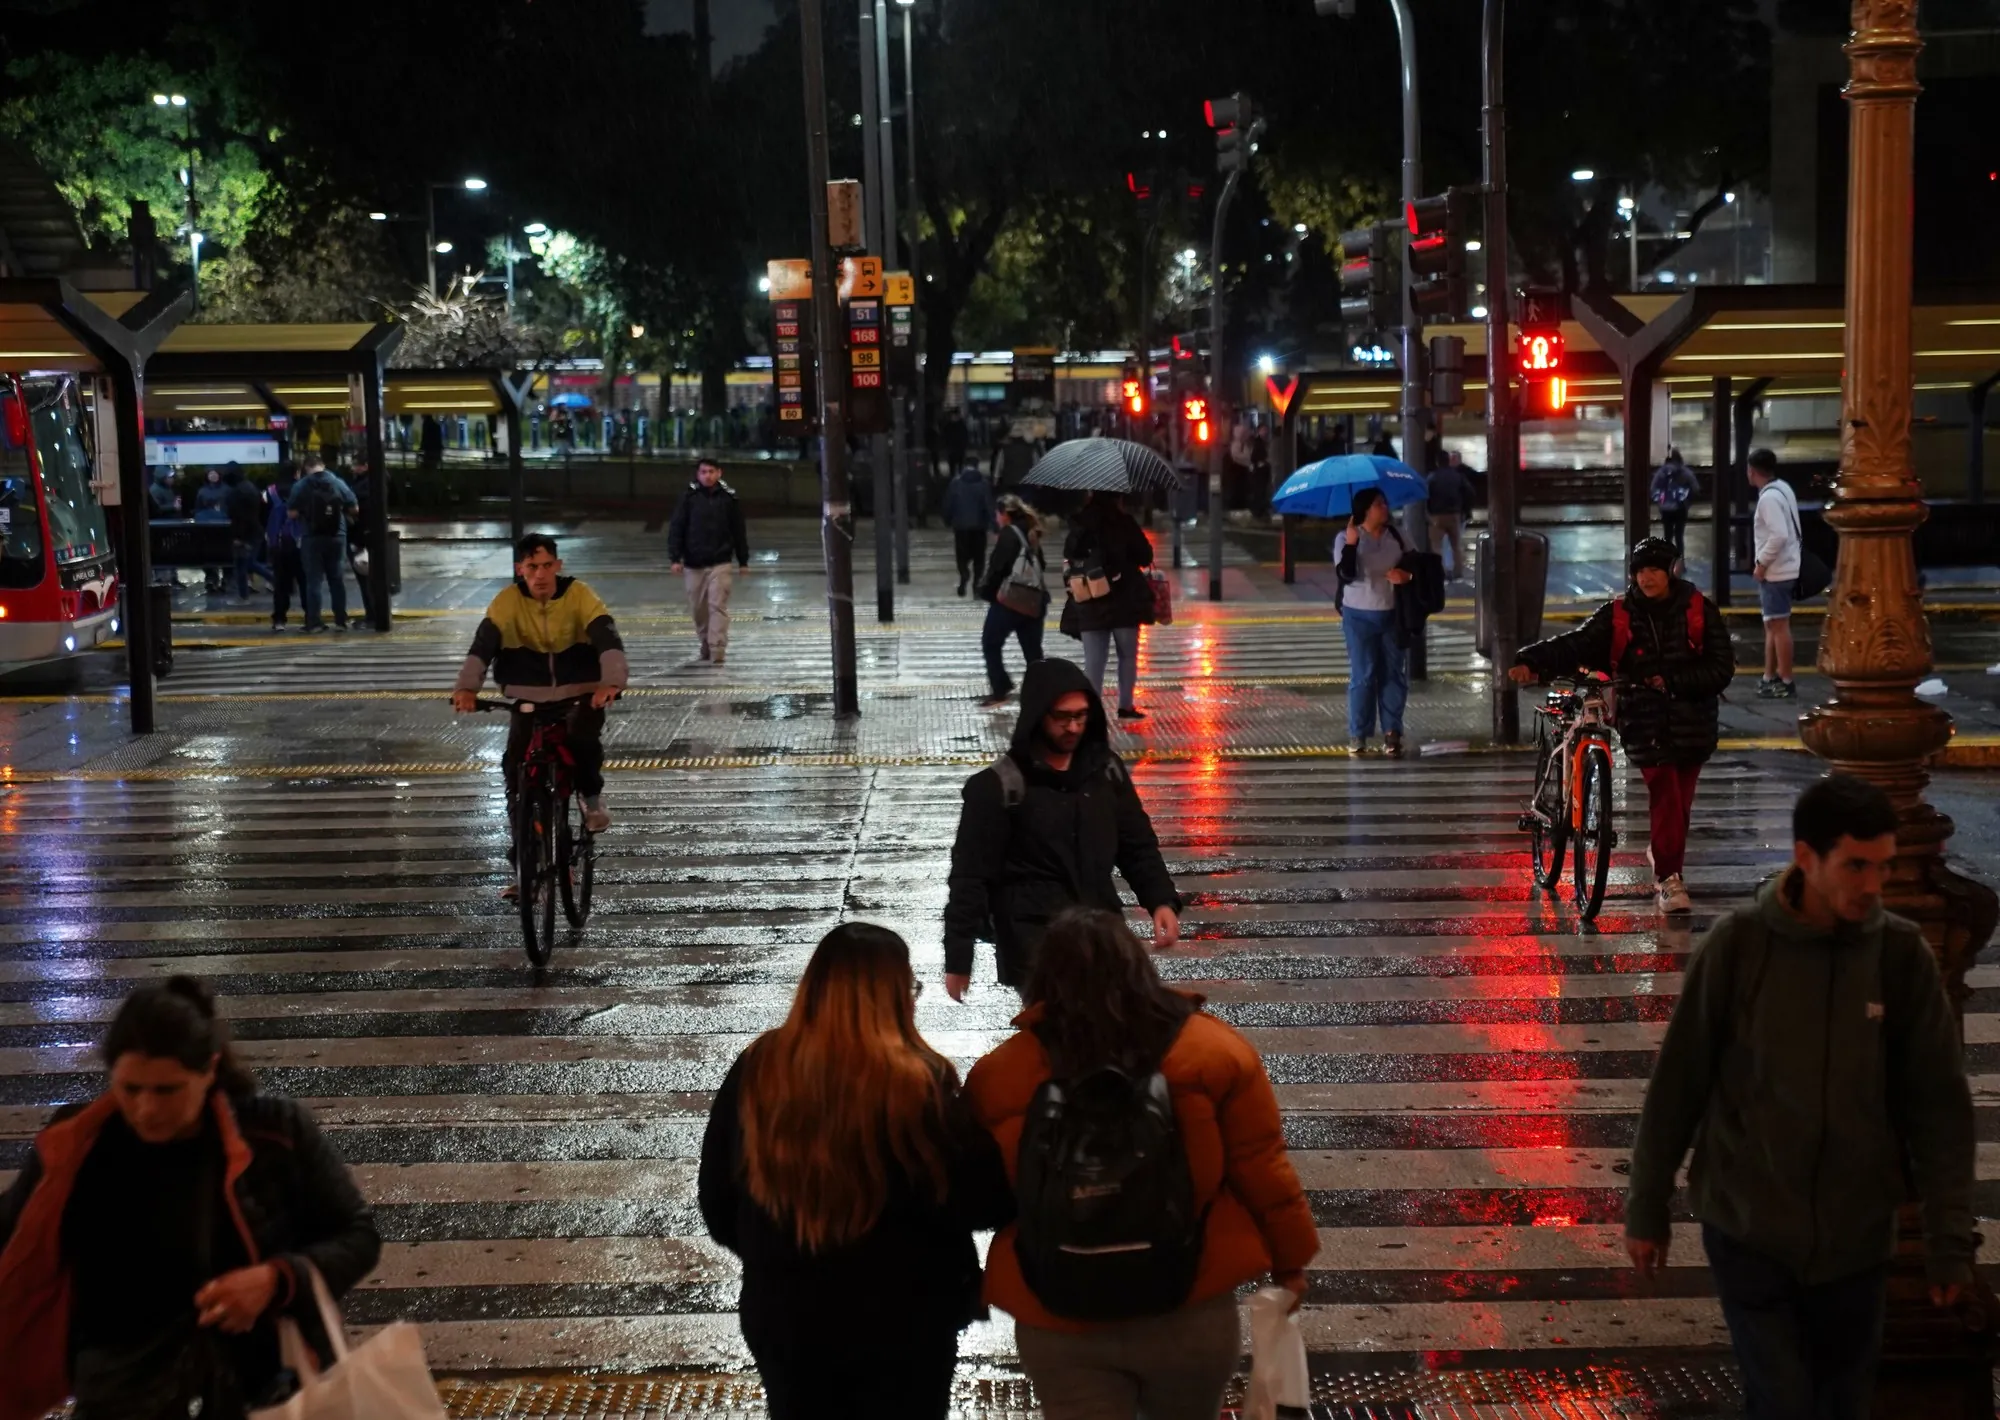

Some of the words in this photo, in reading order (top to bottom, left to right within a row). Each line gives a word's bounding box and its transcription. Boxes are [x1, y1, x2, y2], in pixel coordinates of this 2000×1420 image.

[782, 310, 793, 319] 12
[856, 309, 870, 320] 51
[780, 327, 796, 336] 102
[854, 331, 876, 342] 168
[858, 353, 873, 364] 98
[857, 375, 878, 386] 100
[785, 393, 797, 402] 46
[785, 410, 798, 419] 60
